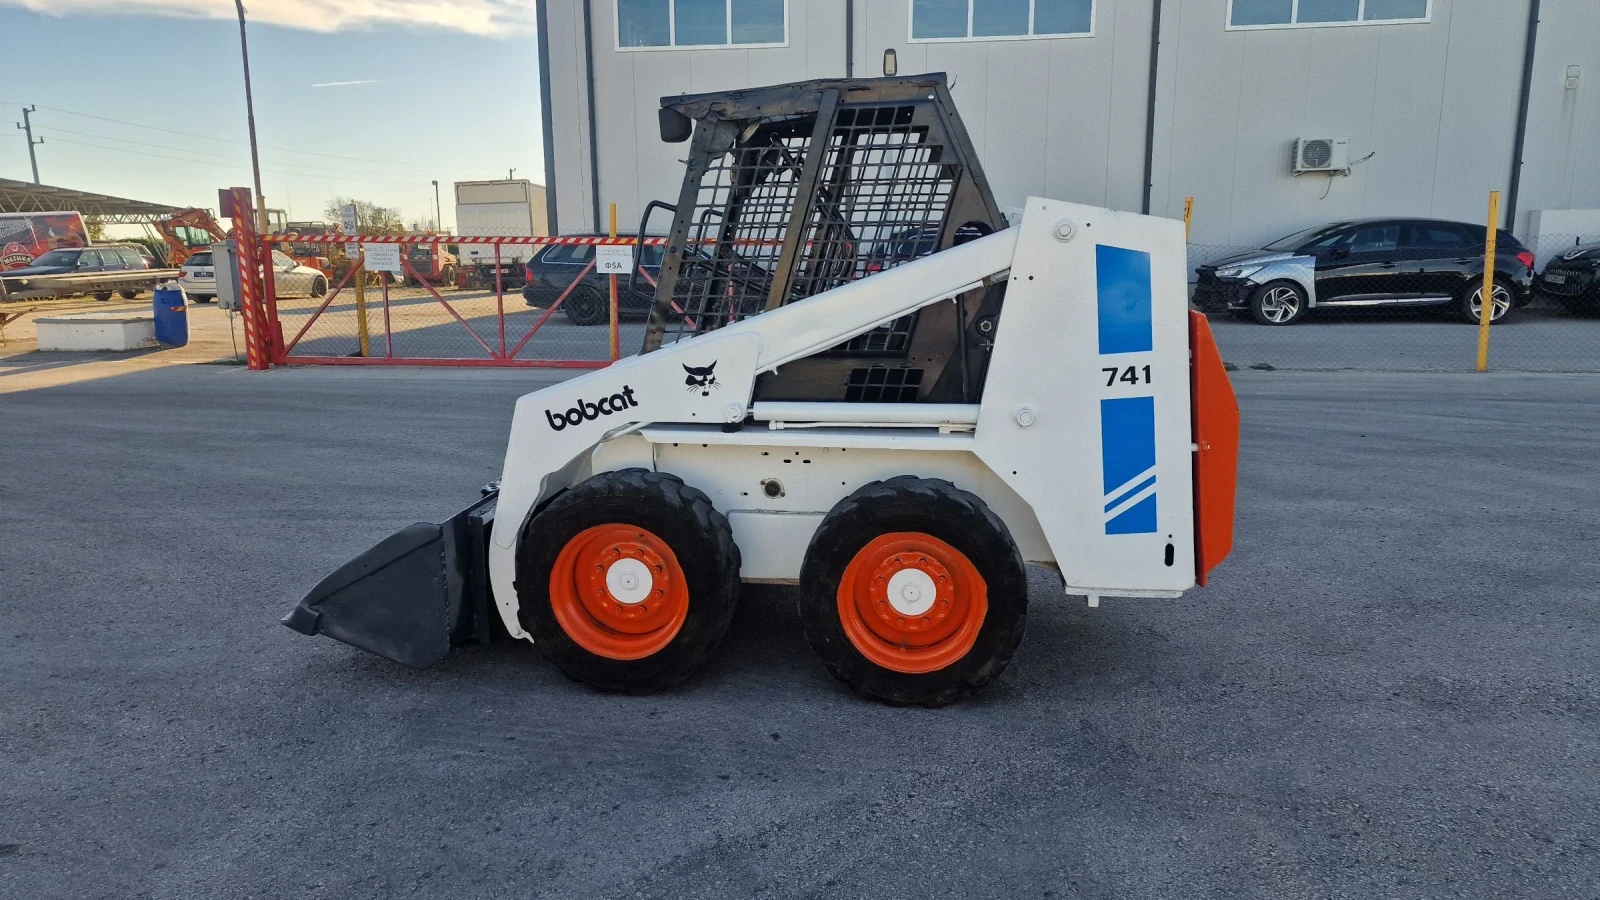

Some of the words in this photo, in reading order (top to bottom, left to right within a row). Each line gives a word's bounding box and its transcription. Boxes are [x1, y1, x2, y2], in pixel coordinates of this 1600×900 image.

[604, 262, 623, 270] Ф5А
[1101, 364, 1151, 387] 741
[544, 384, 639, 432] bobcat
